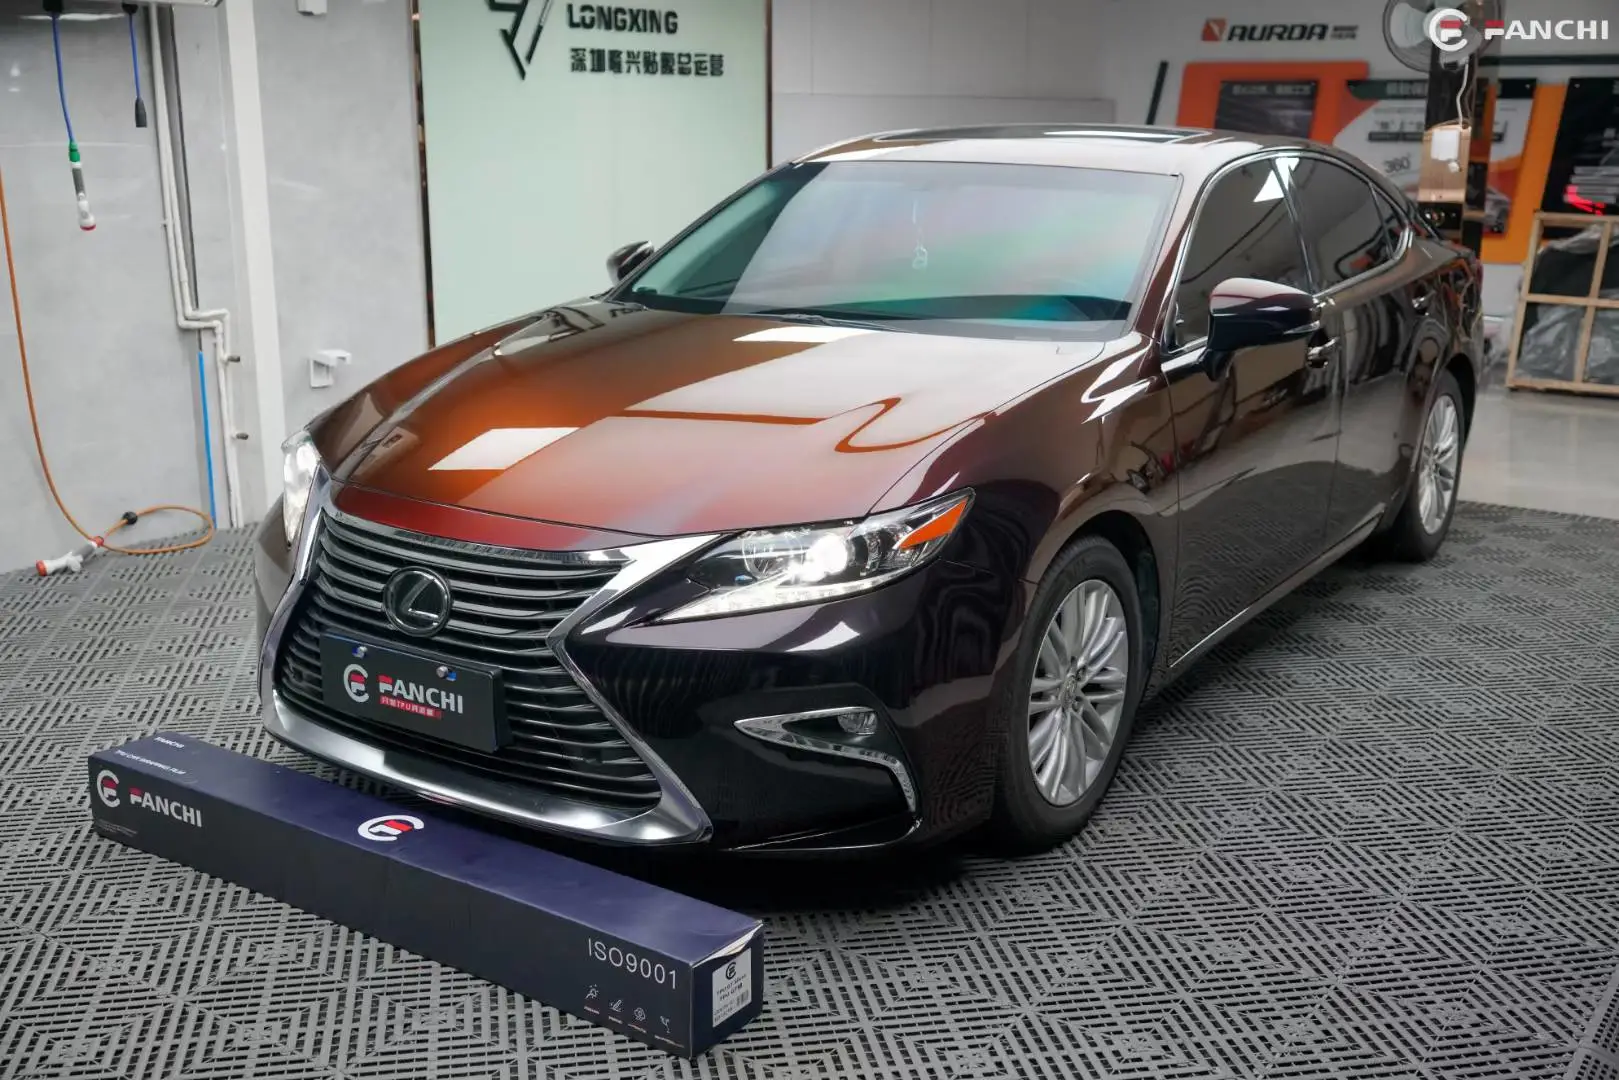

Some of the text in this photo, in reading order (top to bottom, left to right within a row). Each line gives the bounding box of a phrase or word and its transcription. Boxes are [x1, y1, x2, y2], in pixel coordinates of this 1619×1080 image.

[567, 4, 678, 34] LONGXING
[1227, 23, 1329, 42] AURDA
[377, 674, 464, 714] FANCHI
[128, 787, 202, 828] FANCHI
[588, 937, 677, 990] ISO9001
